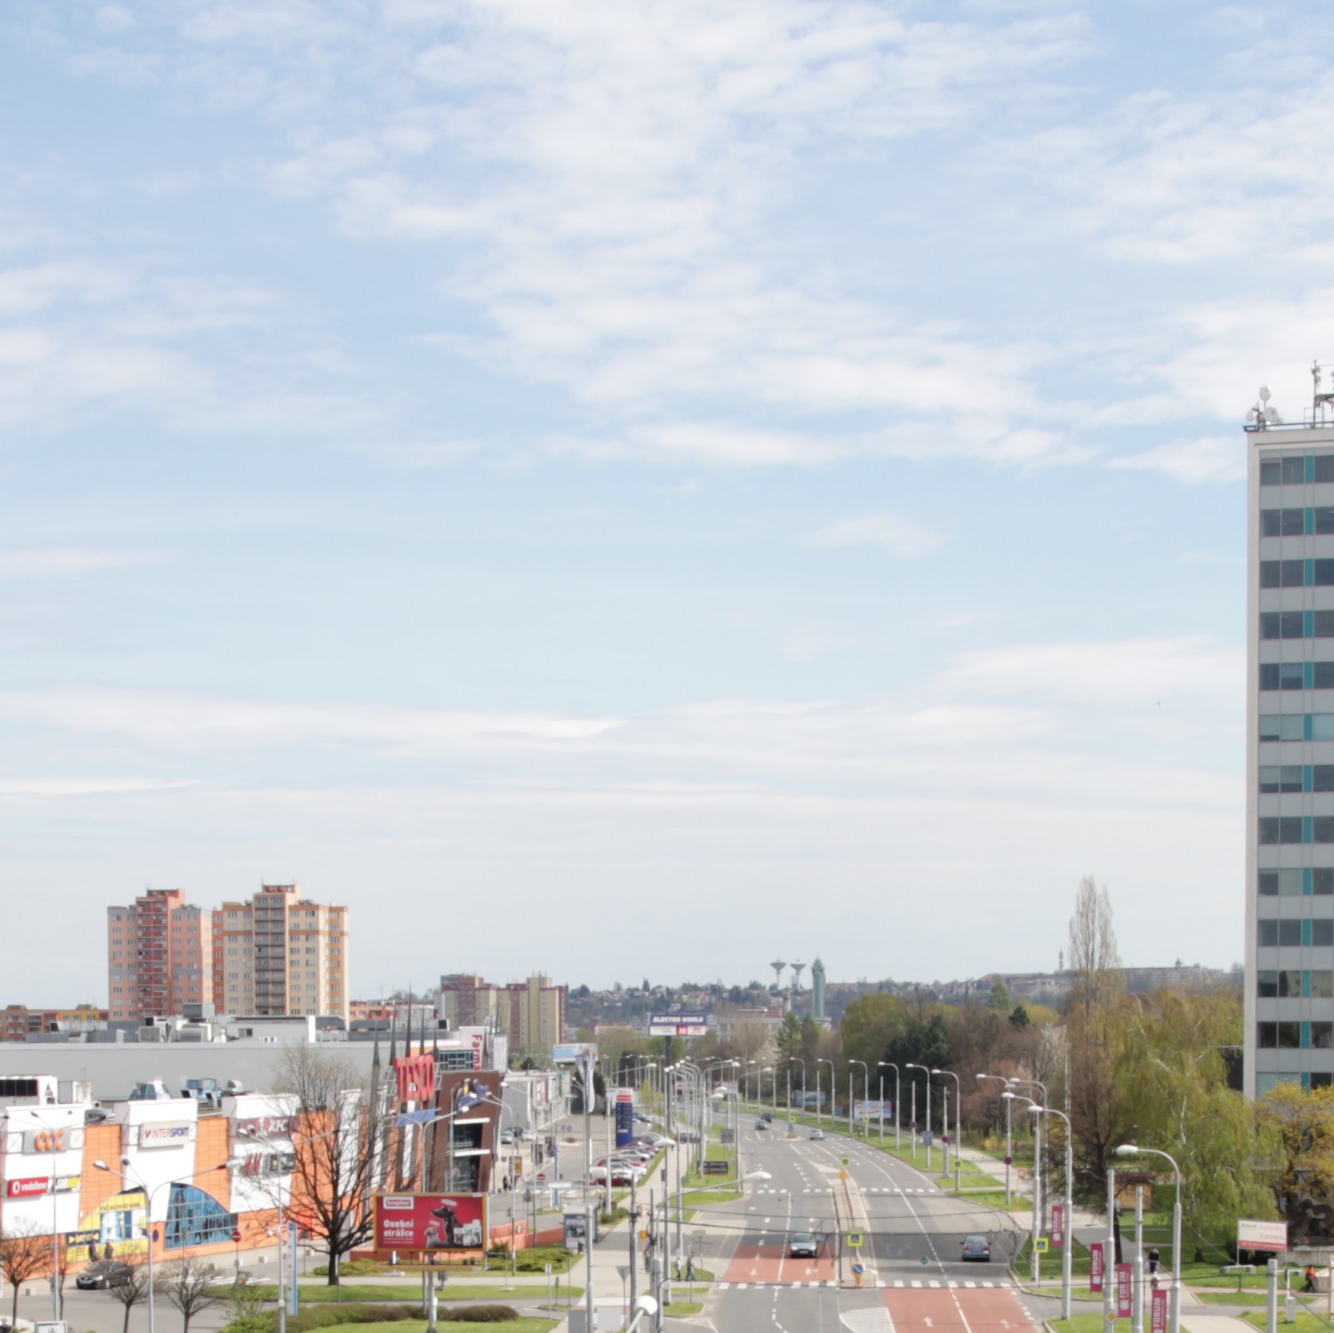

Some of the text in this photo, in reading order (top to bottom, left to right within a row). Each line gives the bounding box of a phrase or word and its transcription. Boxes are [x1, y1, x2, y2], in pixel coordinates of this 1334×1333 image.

[269, 1119, 287, 1132] KFC
[151, 1127, 189, 1138] INTERSPORT
[21, 1180, 47, 1191] vodafone
[383, 1219, 414, 1228] Osobní
[383, 1228, 414, 1237] strážce
[1153, 1298, 1162, 1327] FORUM
